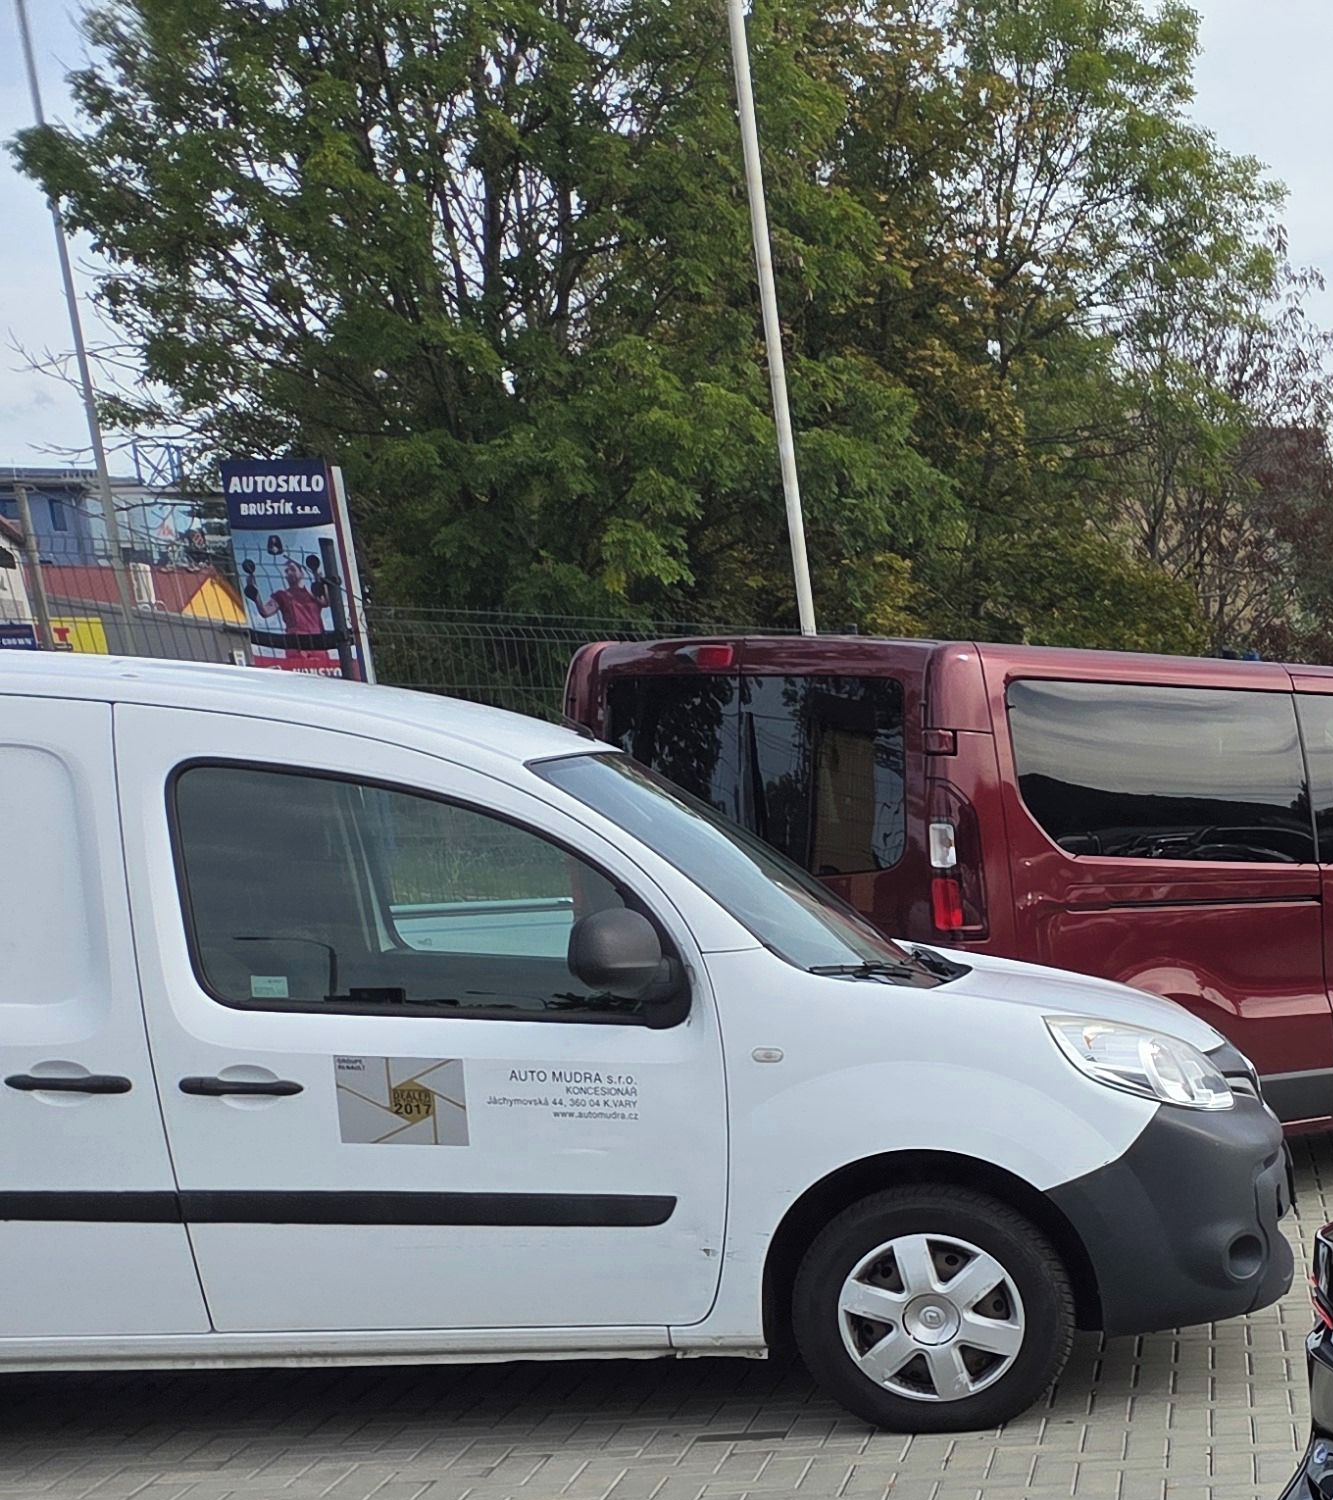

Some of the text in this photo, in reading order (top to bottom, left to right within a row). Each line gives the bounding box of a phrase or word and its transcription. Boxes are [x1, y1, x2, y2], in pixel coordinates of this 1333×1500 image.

[228, 475, 325, 494] AUTOSKLO
[240, 499, 294, 516] BRUŠTÍK
[509, 1070, 638, 1085] AUTO MUDRA s.r.o.
[394, 1103, 432, 1115] 2017
[553, 1110, 639, 1120] www.automudra.cz
